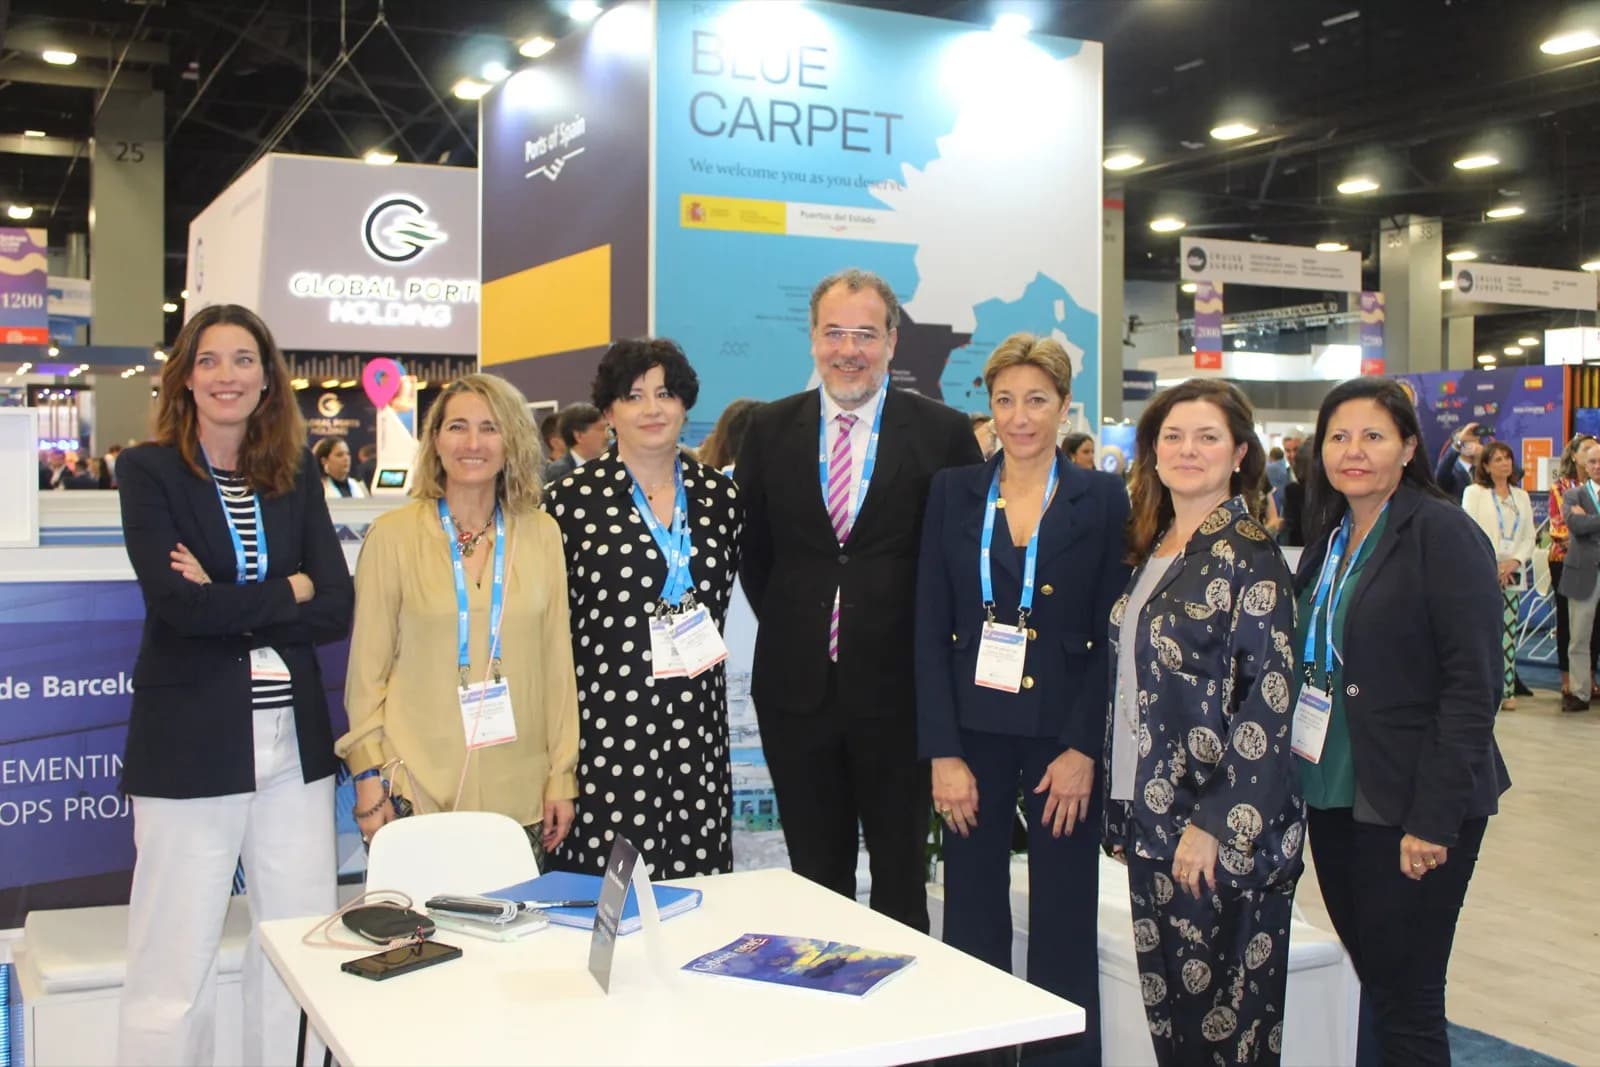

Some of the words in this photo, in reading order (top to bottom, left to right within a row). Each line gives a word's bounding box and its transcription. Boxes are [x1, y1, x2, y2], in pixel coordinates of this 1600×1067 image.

[691, 29, 828, 90] BLUE
[689, 91, 904, 156] CARPET
[115, 142, 144, 163] 25
[689, 158, 713, 174] We
[716, 162, 779, 181] welcome
[781, 169, 806, 184] you
[809, 171, 825, 184] as
[826, 173, 851, 188] you
[854, 173, 905, 192] deserve
[800, 210, 831, 221] Puertos
[291, 273, 399, 298] GLOBAL
[2, 292, 43, 309] 1200
[329, 301, 451, 327] HOLDING
[0, 677, 30, 699] de
[0, 800, 52, 826] OPS
[65, 793, 129, 821] PROJ
